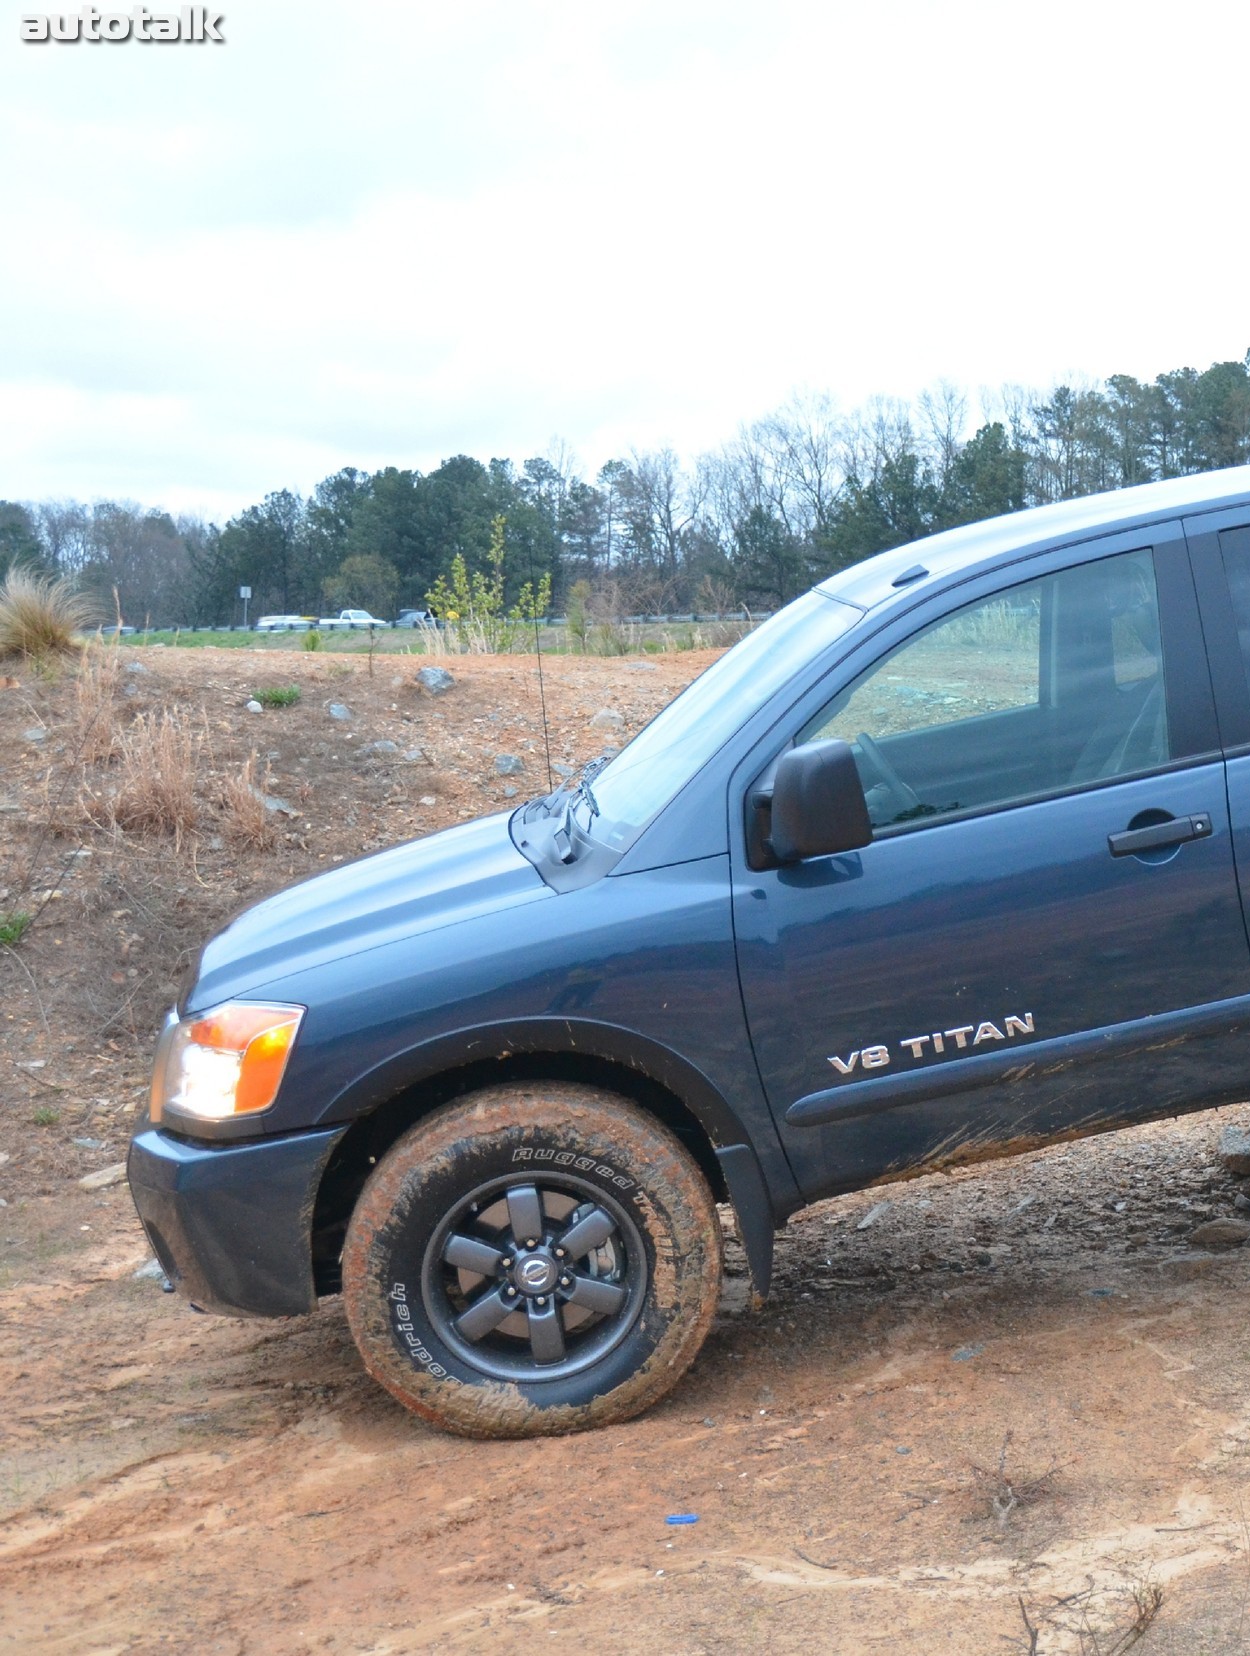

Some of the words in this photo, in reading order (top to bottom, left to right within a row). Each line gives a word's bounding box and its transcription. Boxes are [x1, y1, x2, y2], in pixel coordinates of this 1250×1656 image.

[827, 1045, 891, 1075] V8
[900, 1012, 1036, 1059] TITAN
[511, 1147, 635, 1190] Rugged
